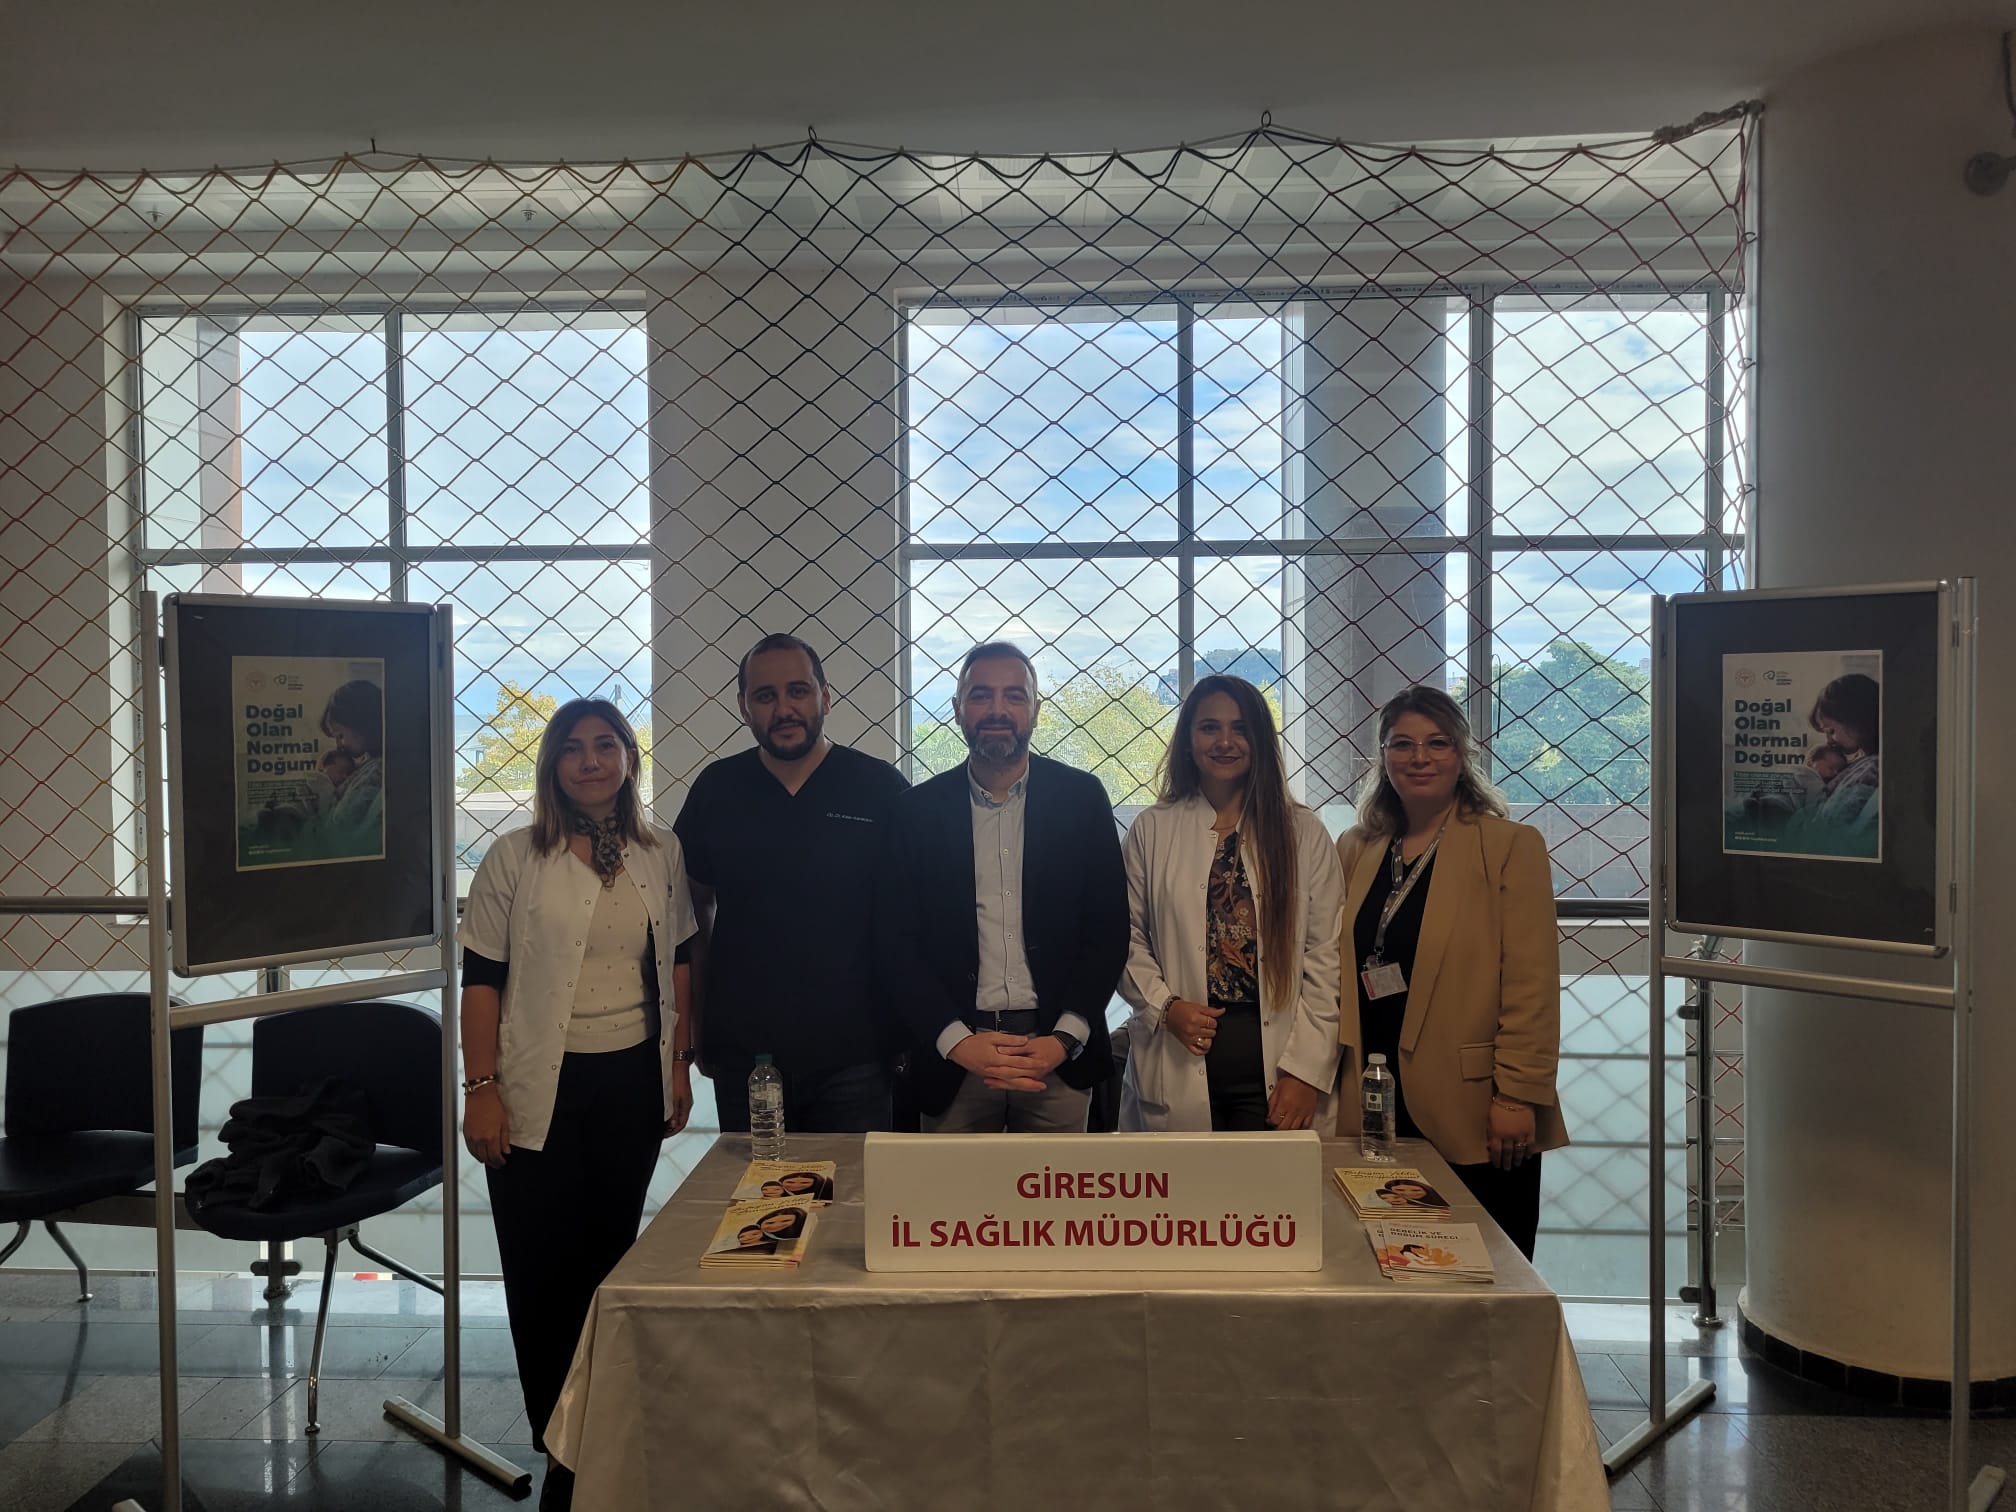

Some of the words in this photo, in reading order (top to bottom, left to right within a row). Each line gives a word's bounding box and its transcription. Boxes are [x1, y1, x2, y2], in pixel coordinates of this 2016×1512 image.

[245, 703, 303, 722] Doğal
[1734, 699, 1792, 716] Doğal
[246, 722, 293, 737] Olan
[1734, 716, 1781, 730] Olan
[247, 738, 320, 755] Normal
[1734, 733, 1808, 748] Normal
[247, 757, 317, 775] Doğum
[1734, 750, 1805, 767] Doğum
[1016, 1166, 1170, 1199] GİRESUN
[891, 1214, 921, 1248] İL
[929, 1214, 1056, 1248] SAĞLIK
[1064, 1213, 1297, 1247] MÜDÜRLÜĞÜ
